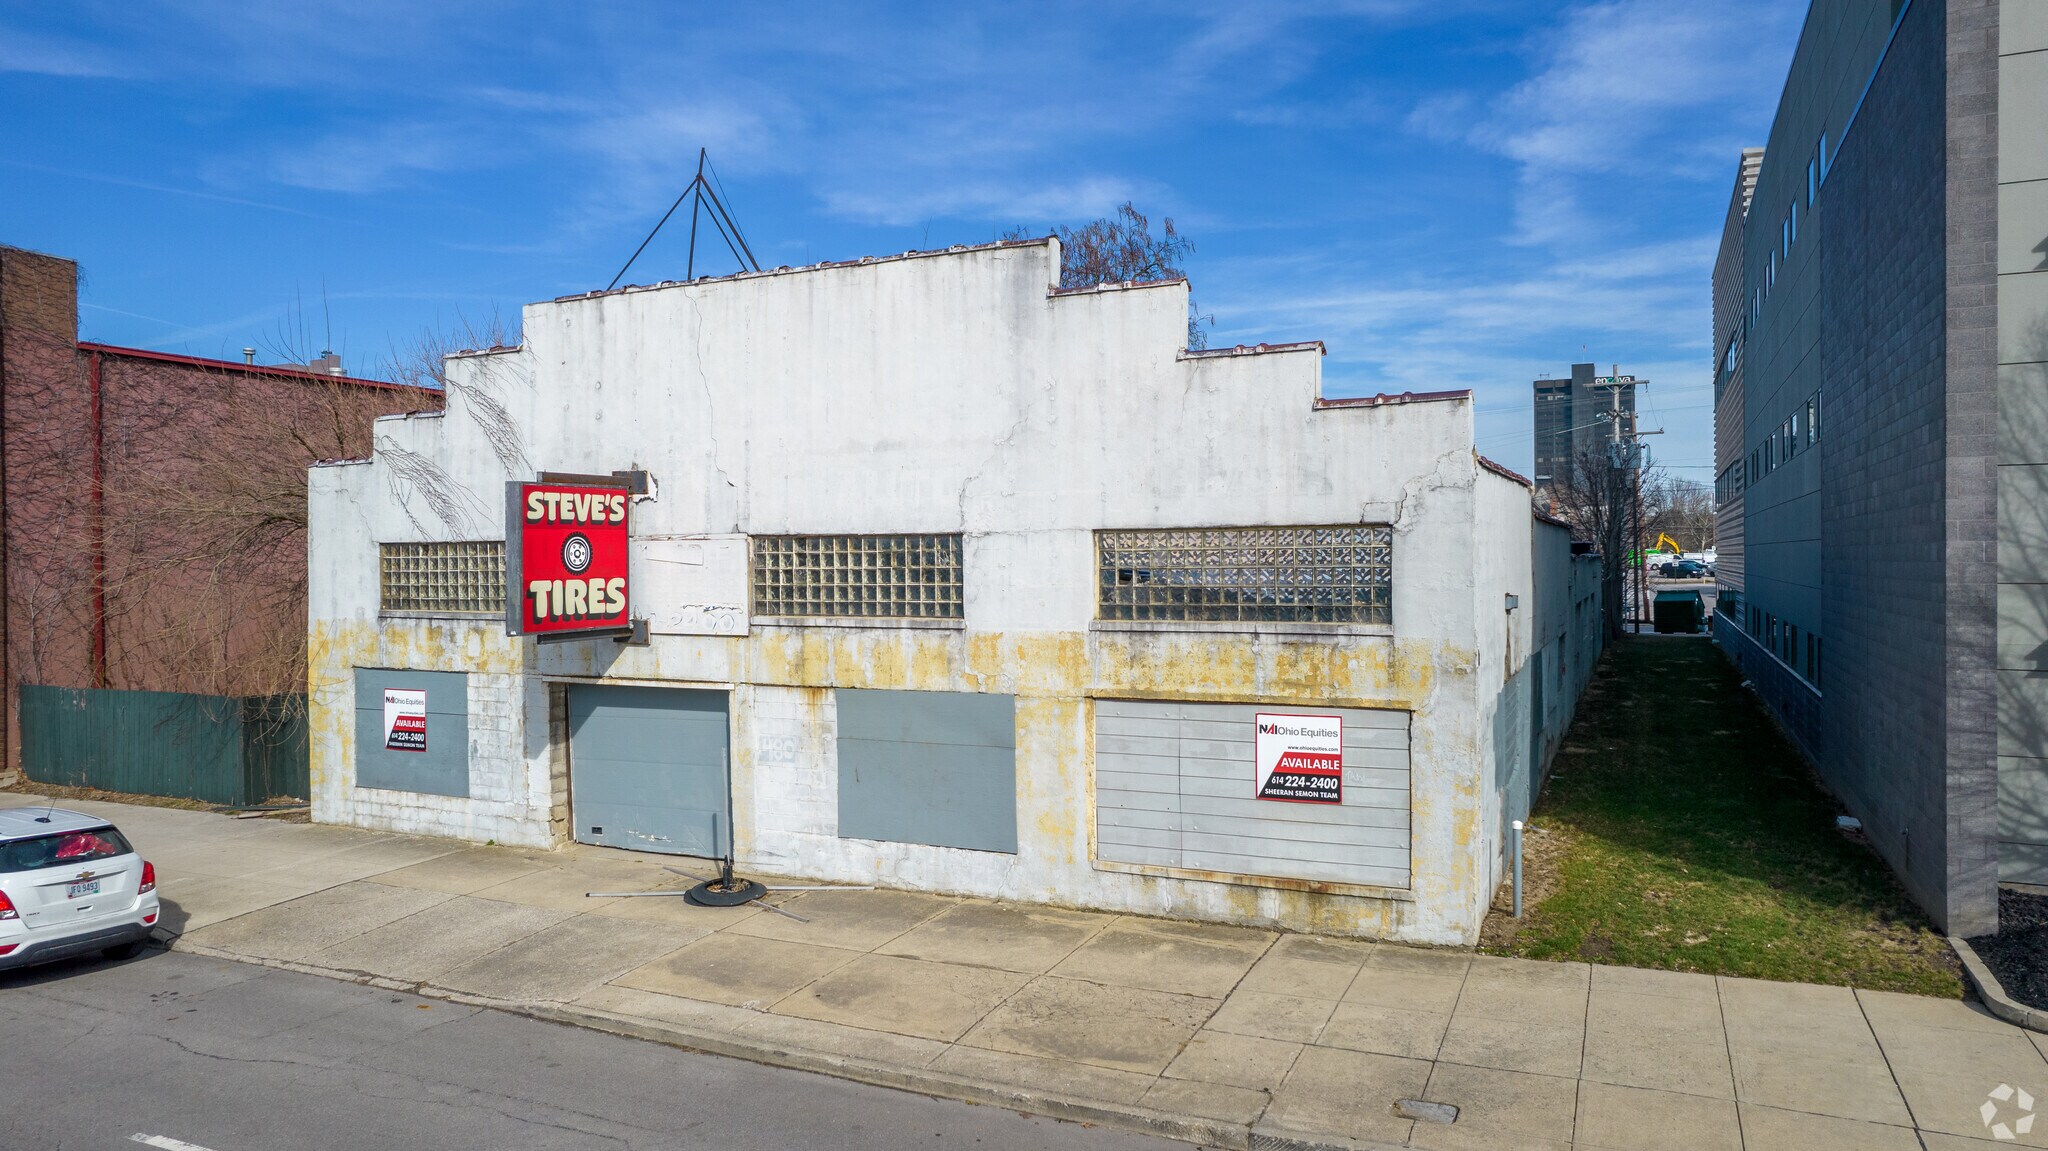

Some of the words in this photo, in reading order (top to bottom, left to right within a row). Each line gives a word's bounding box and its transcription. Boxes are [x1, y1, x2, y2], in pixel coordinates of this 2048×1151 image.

[527, 491, 625, 523] STEVE'S
[529, 577, 626, 619] TIRES
[396, 720, 425, 728] AVAILABLE
[398, 732, 424, 741] 224-2400
[1300, 727, 1339, 739] Equities
[1281, 757, 1340, 770] AVAILABLE
[1271, 776, 1284, 784] 614
[1284, 775, 1338, 790] 224-2400
[1264, 788, 1294, 797] SHEERAN
[1295, 790, 1319, 798] SEMON
[82, 881, 98, 892] 9493
